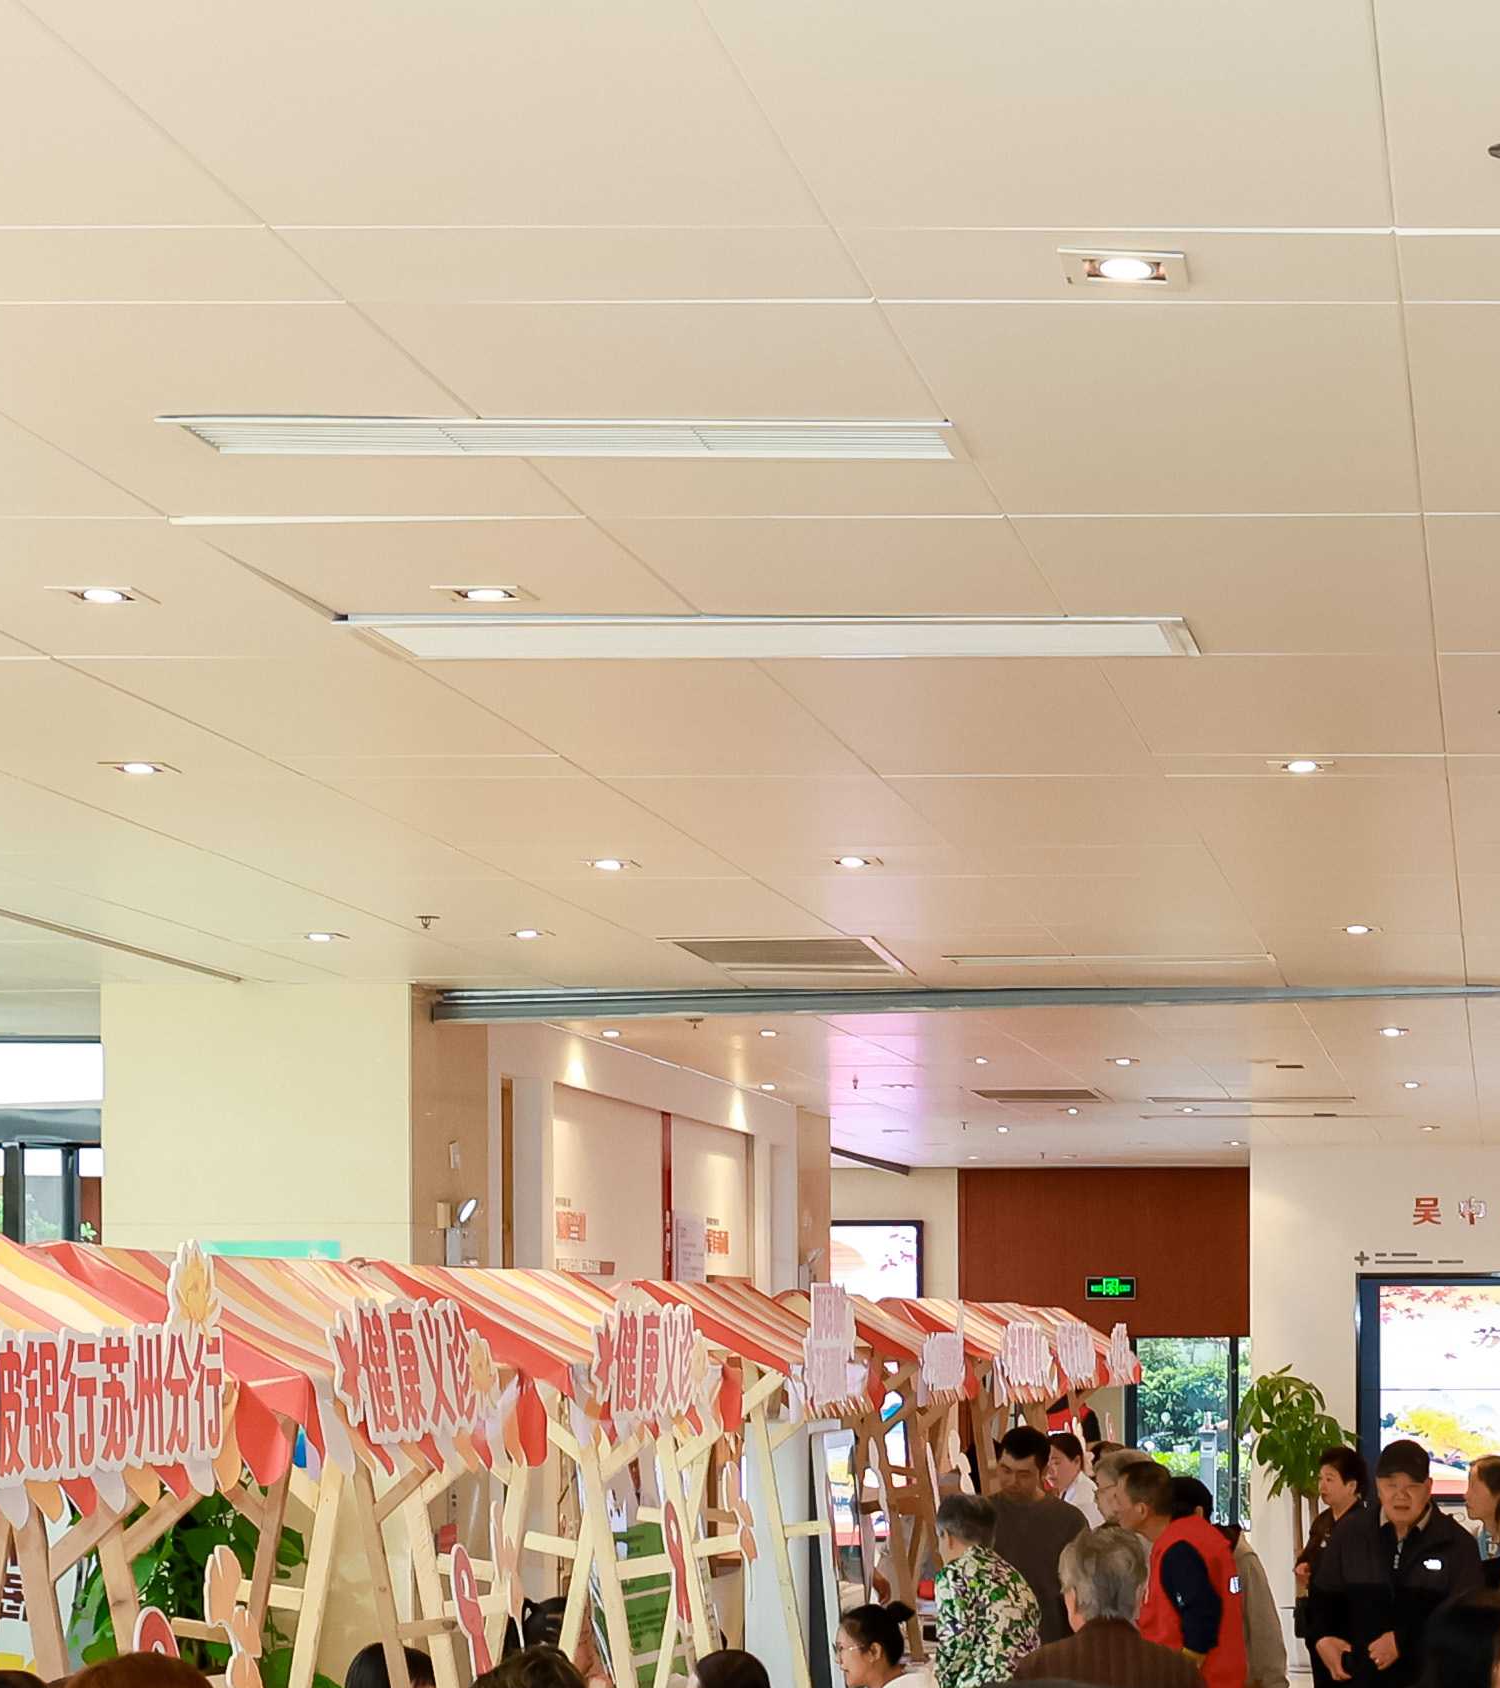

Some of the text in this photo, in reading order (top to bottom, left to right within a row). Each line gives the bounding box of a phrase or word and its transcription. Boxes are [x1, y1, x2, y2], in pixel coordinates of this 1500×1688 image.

[361, 1307, 476, 1433] 健康义诊
[615, 1310, 696, 1412] 健康义诊
